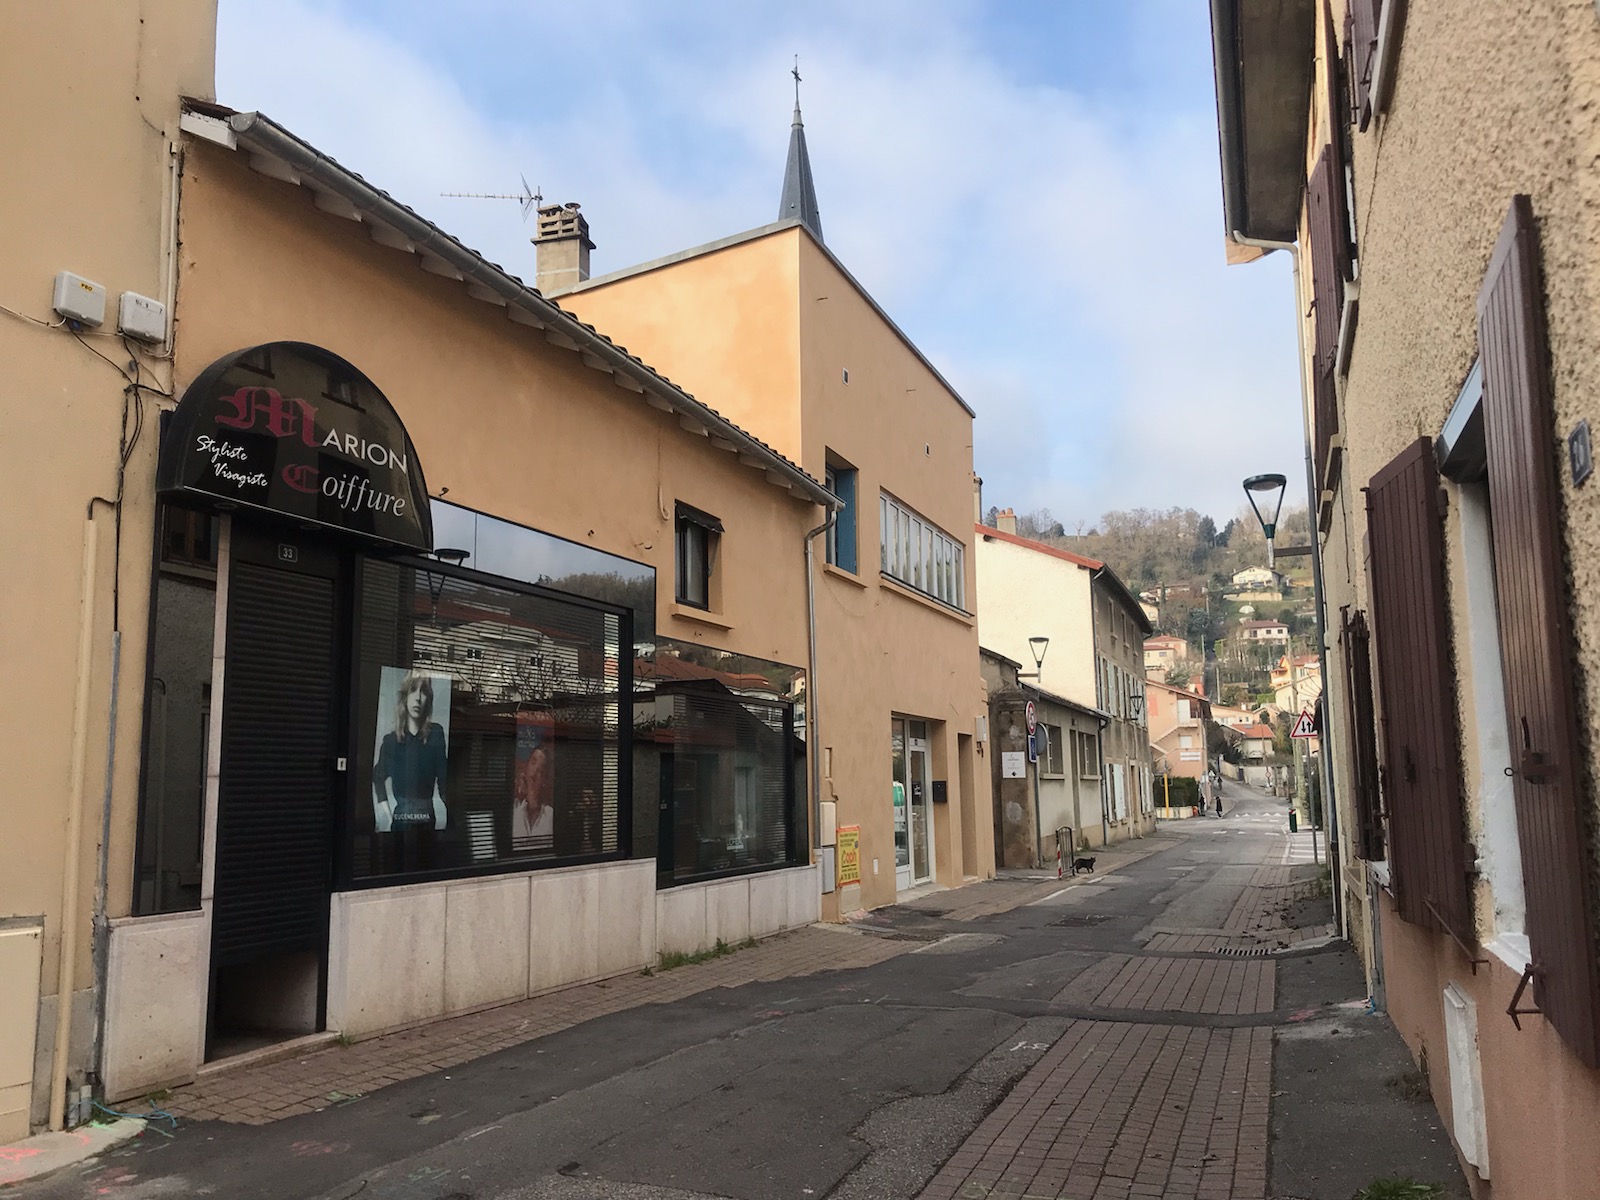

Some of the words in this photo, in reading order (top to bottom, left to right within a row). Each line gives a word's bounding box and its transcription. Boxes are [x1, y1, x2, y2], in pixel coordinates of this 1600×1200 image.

[196, 434, 249, 463] Styliste
[213, 462, 268, 489] Visagiste
[282, 463, 406, 517] Coiffure
[283, 547, 293, 559] 33
